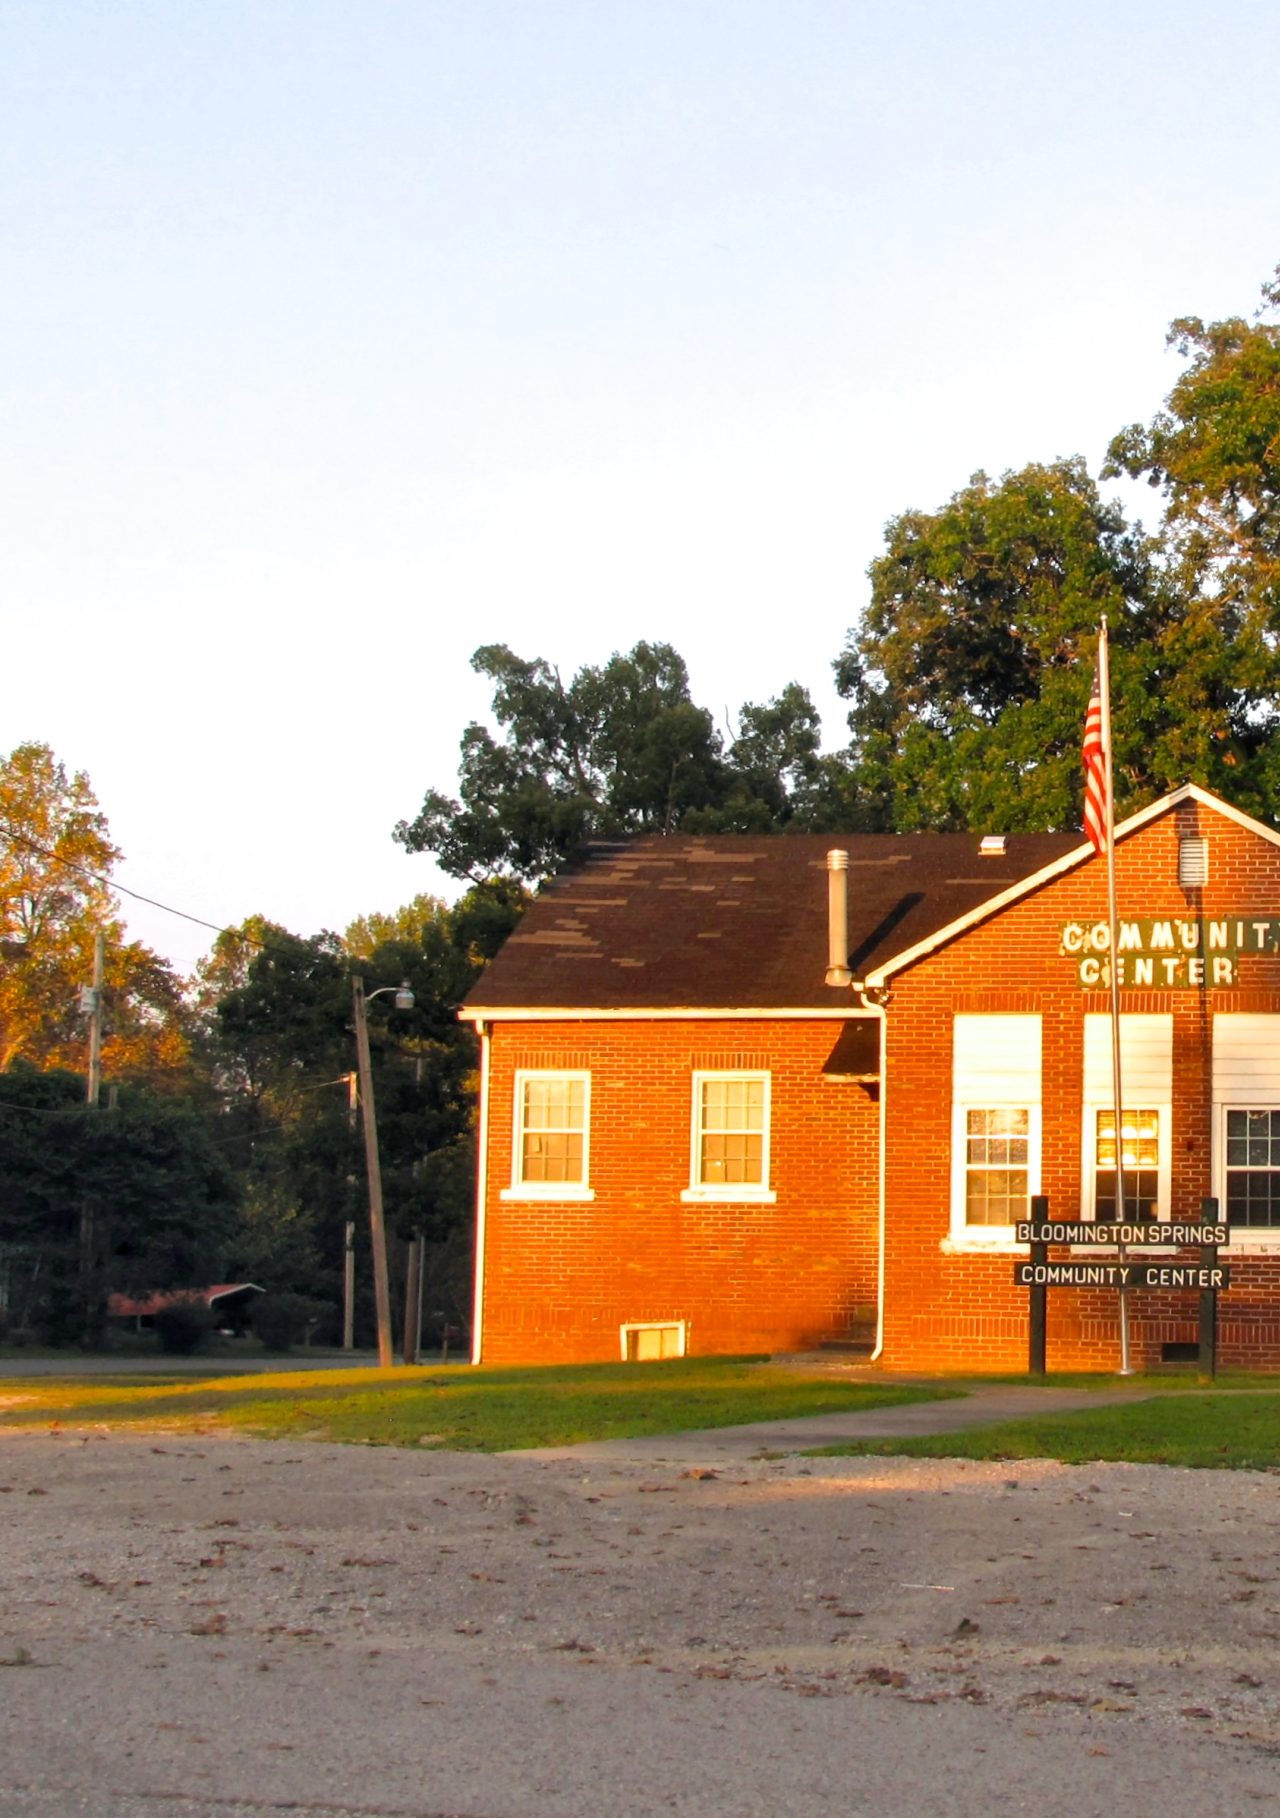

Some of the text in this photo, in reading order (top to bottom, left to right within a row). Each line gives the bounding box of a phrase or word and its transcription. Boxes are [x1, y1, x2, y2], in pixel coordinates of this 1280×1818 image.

[1018, 1224, 1226, 1244] BLOOMINGTON SPRINGS
[1021, 1265, 1223, 1287] COMMUNITY CENTER
